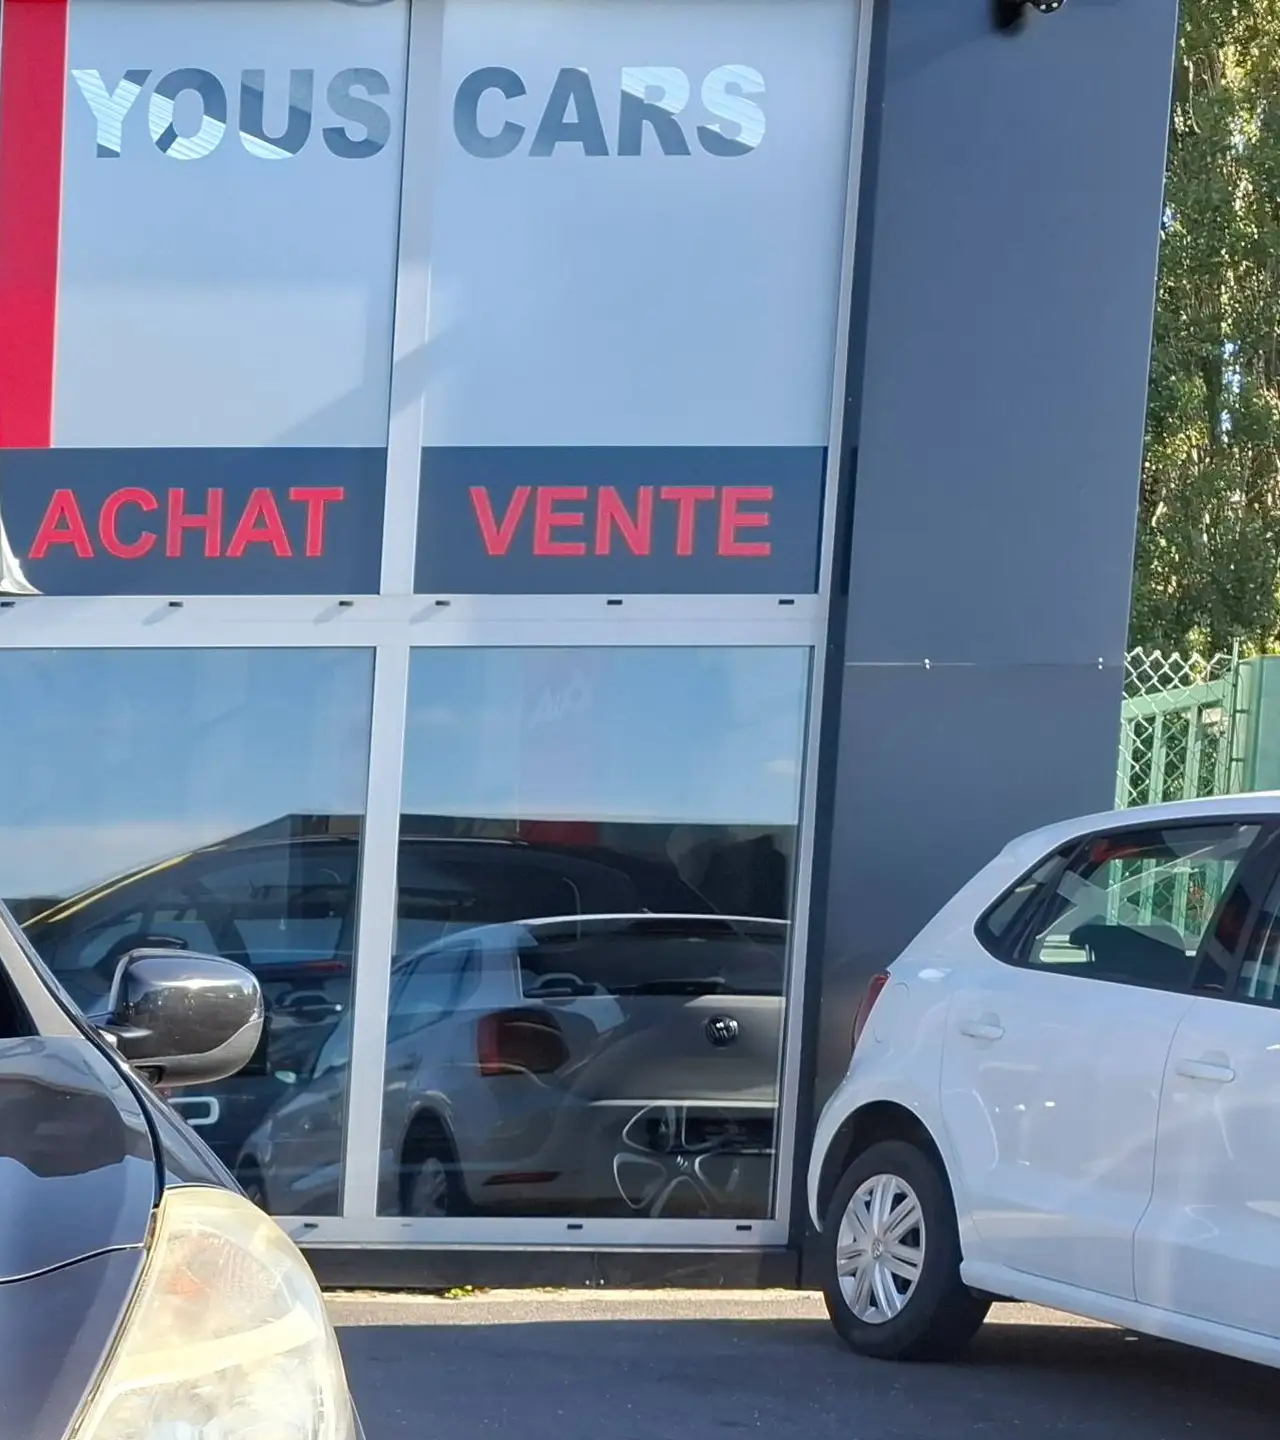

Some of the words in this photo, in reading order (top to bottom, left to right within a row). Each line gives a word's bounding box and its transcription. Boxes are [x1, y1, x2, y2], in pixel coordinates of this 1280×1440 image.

[70, 66, 392, 161] YOUS
[452, 64, 768, 160] CARS
[28, 486, 344, 559] ACHAT
[468, 485, 774, 557] VENTE
